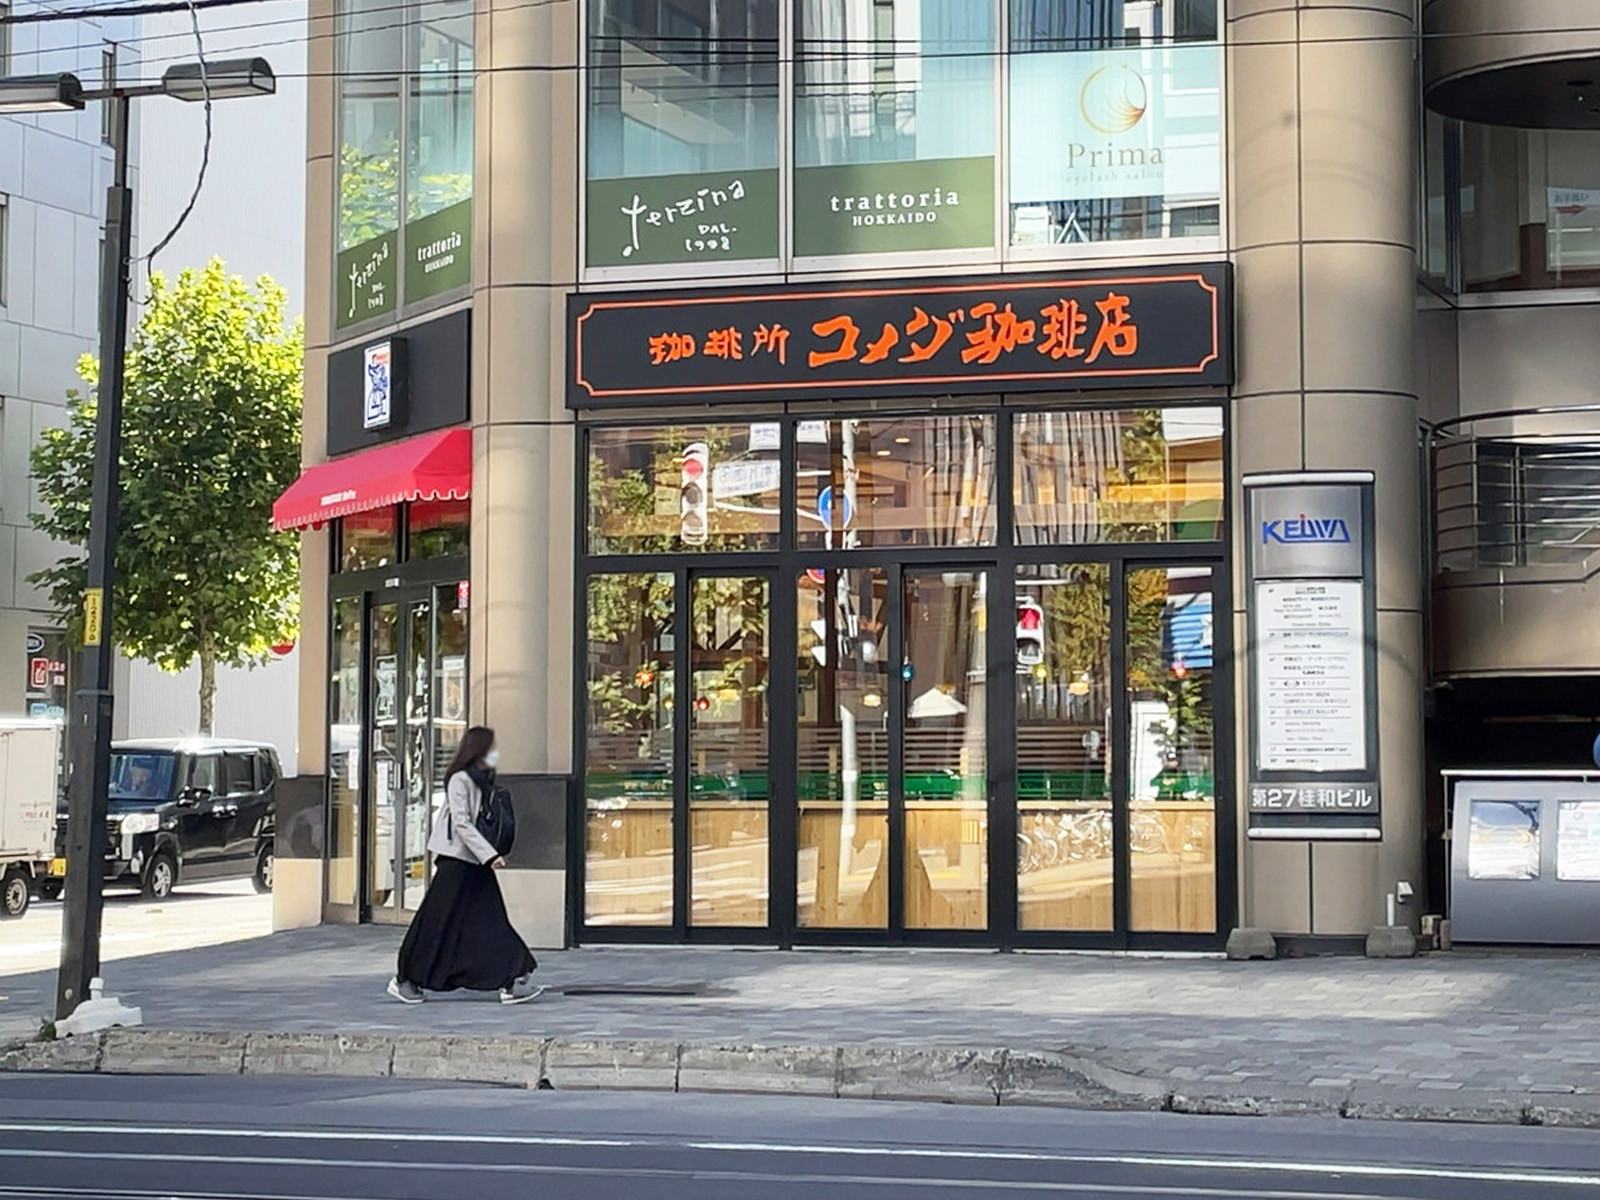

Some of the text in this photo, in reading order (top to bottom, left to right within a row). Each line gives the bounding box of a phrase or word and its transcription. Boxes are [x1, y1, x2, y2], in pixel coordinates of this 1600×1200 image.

[1066, 142, 1164, 169] Prima
[830, 187, 959, 212] trattoria
[852, 211, 937, 227] HOKKAIDO
[417, 231, 462, 262] trattoria
[685, 235, 731, 251] 1998
[648, 292, 1139, 369] 珈琲所 コメダ珈琲店
[1252, 788, 1372, 808] 第27桂和ビル
